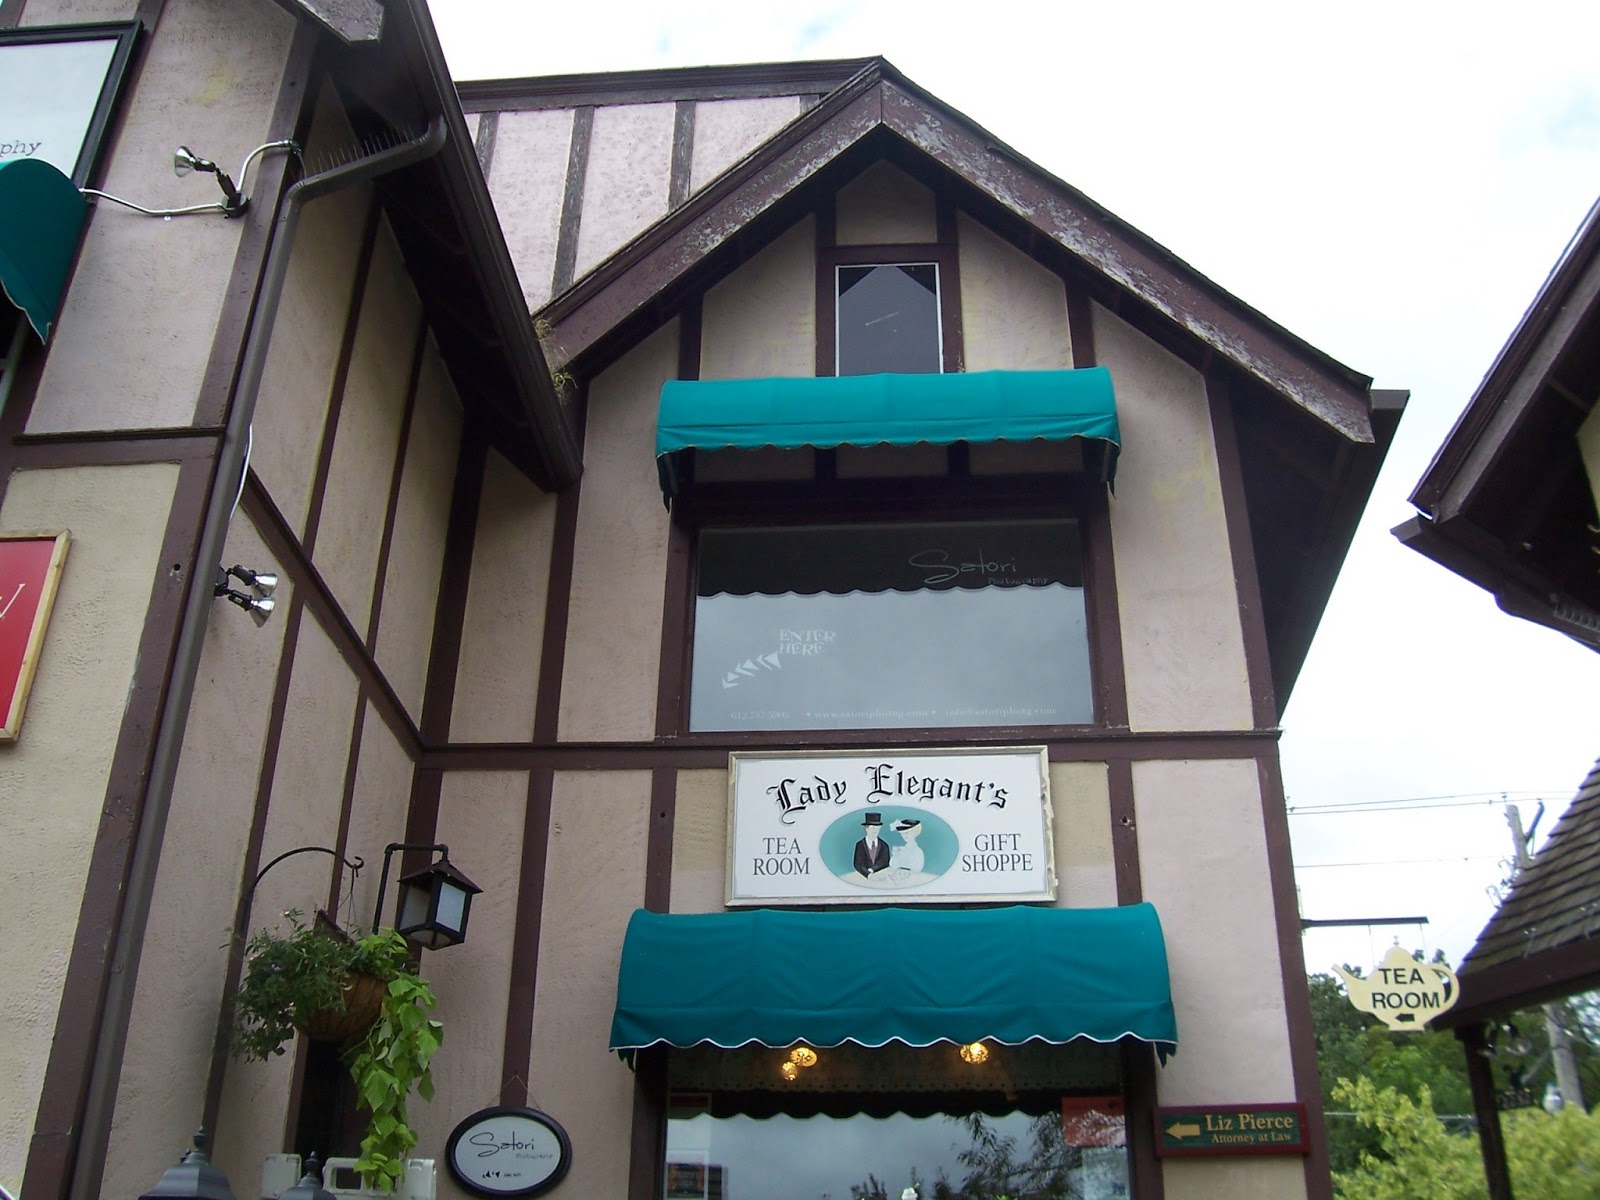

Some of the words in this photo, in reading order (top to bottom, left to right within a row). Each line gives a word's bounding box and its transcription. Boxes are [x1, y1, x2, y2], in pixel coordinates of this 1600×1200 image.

[909, 547, 1017, 584] Satori
[780, 629, 836, 642] ENTER
[780, 641, 825, 656] HERE
[765, 775, 848, 825] Lady
[865, 763, 1010, 809] Elegant's
[762, 837, 803, 855] TEA
[974, 833, 1022, 851] GIFT
[752, 857, 811, 876] ROOM
[962, 853, 1034, 873] SHOPPE
[1378, 968, 1425, 985] TEA
[1371, 992, 1440, 1009] ROOM
[1205, 1114, 1234, 1131] Liz
[1238, 1113, 1294, 1130] Pierce
[469, 1131, 535, 1157] Satori
[1212, 1133, 1255, 1145] Attorney
[1258, 1133, 1269, 1142] at
[1271, 1131, 1292, 1141] Law
